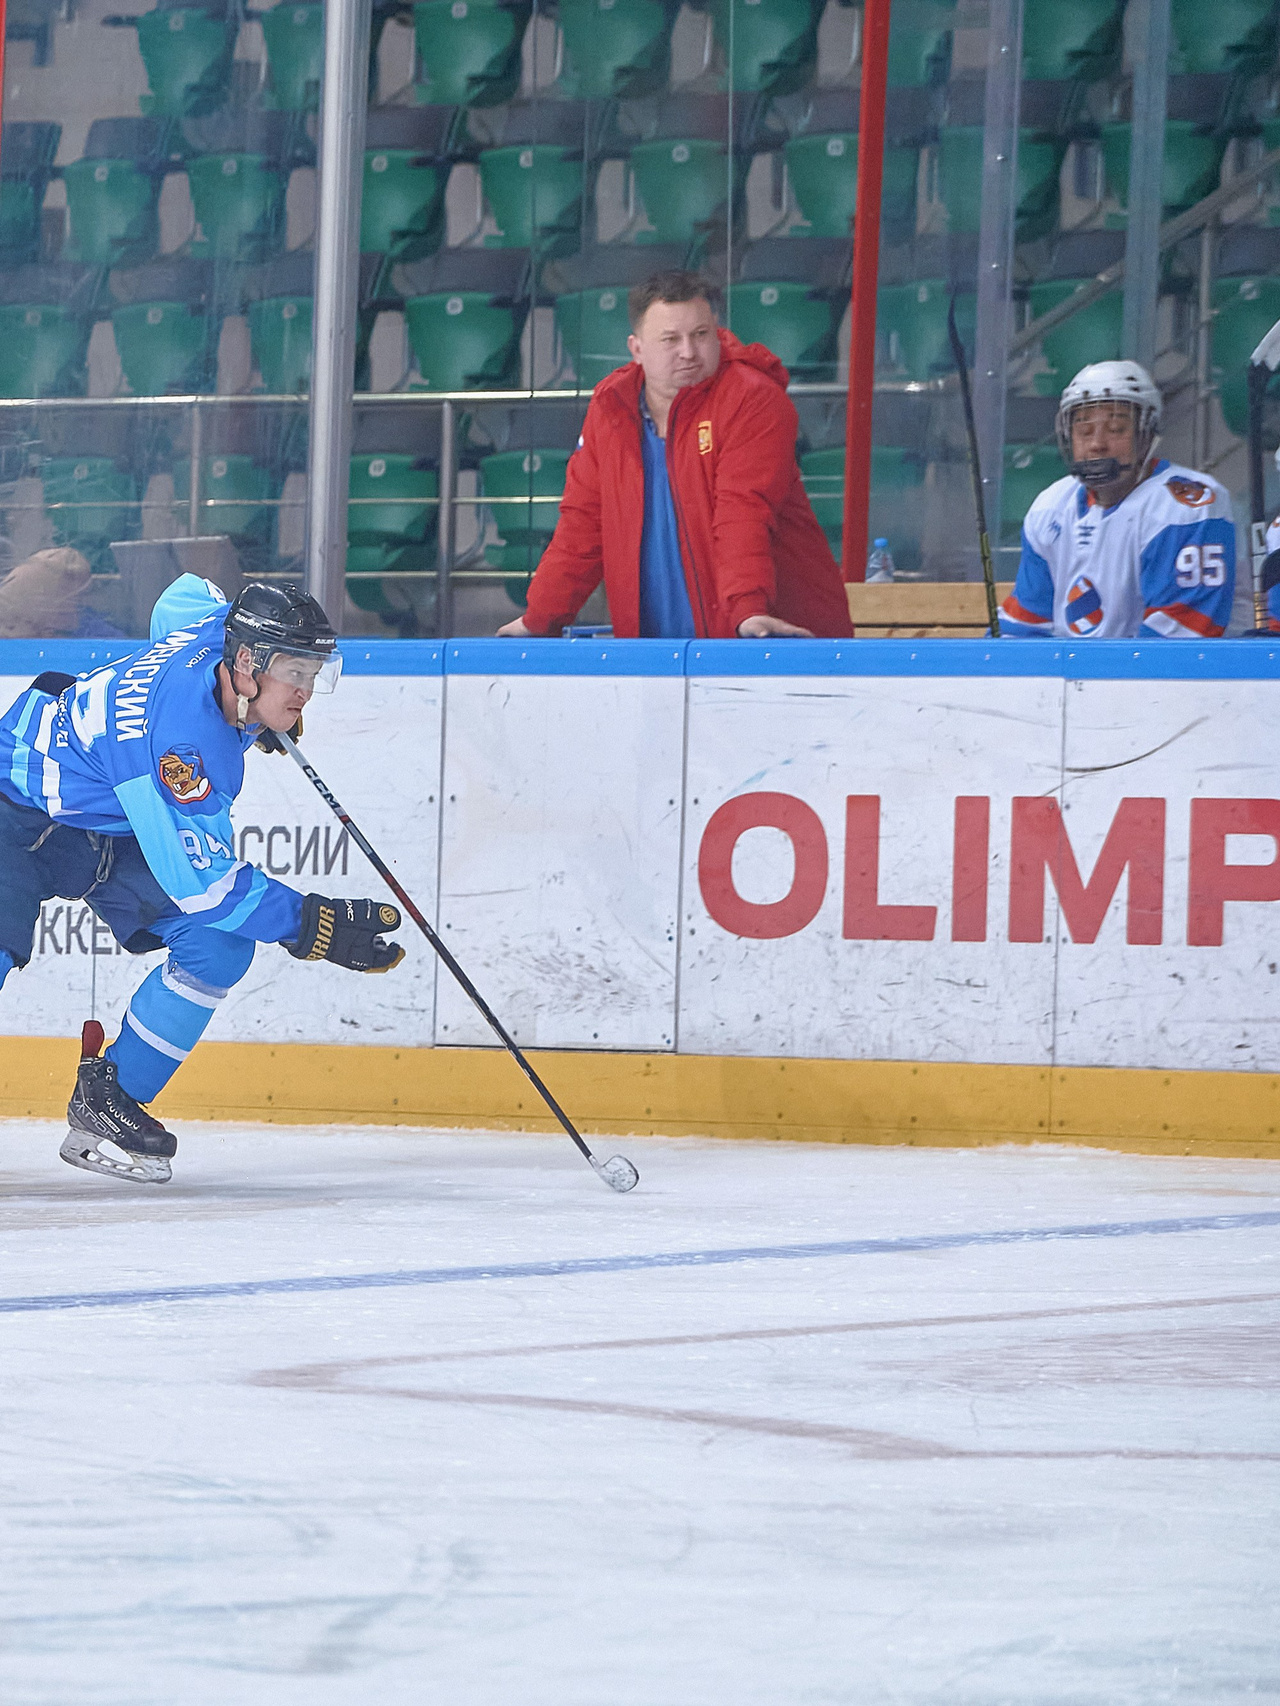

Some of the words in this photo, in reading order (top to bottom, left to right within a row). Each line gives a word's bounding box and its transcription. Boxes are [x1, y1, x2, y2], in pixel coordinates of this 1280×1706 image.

[1176, 544, 1226, 589] 95
[302, 764, 341, 808] CCM
[232, 825, 349, 876] ССИИ
[697, 790, 1280, 947] OLIMP
